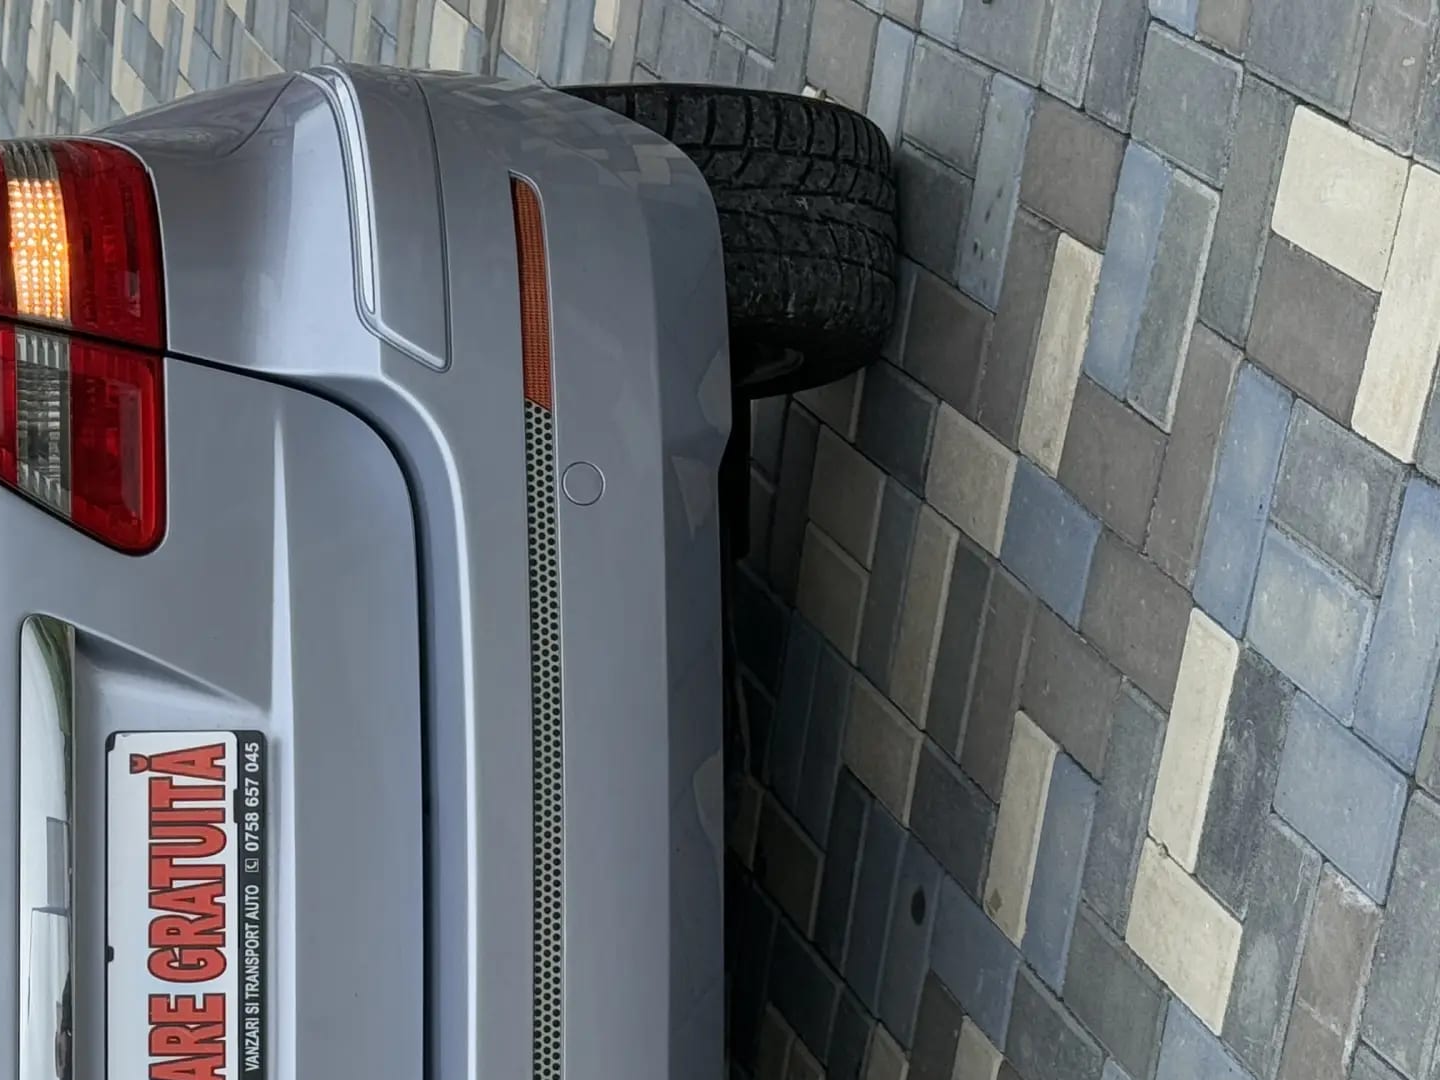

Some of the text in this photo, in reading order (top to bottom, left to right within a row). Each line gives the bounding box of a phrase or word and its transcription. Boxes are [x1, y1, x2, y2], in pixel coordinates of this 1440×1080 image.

[244, 742, 260, 772] 045
[244, 777, 260, 807] 657
[244, 812, 260, 852] 0758
[130, 742, 227, 983] GRATUITĂ
[244, 885, 260, 920] AUTO
[244, 923, 260, 1000] TRANSPORT
[244, 1002, 260, 1014] SI
[244, 1017, 260, 1071] VANZARI
